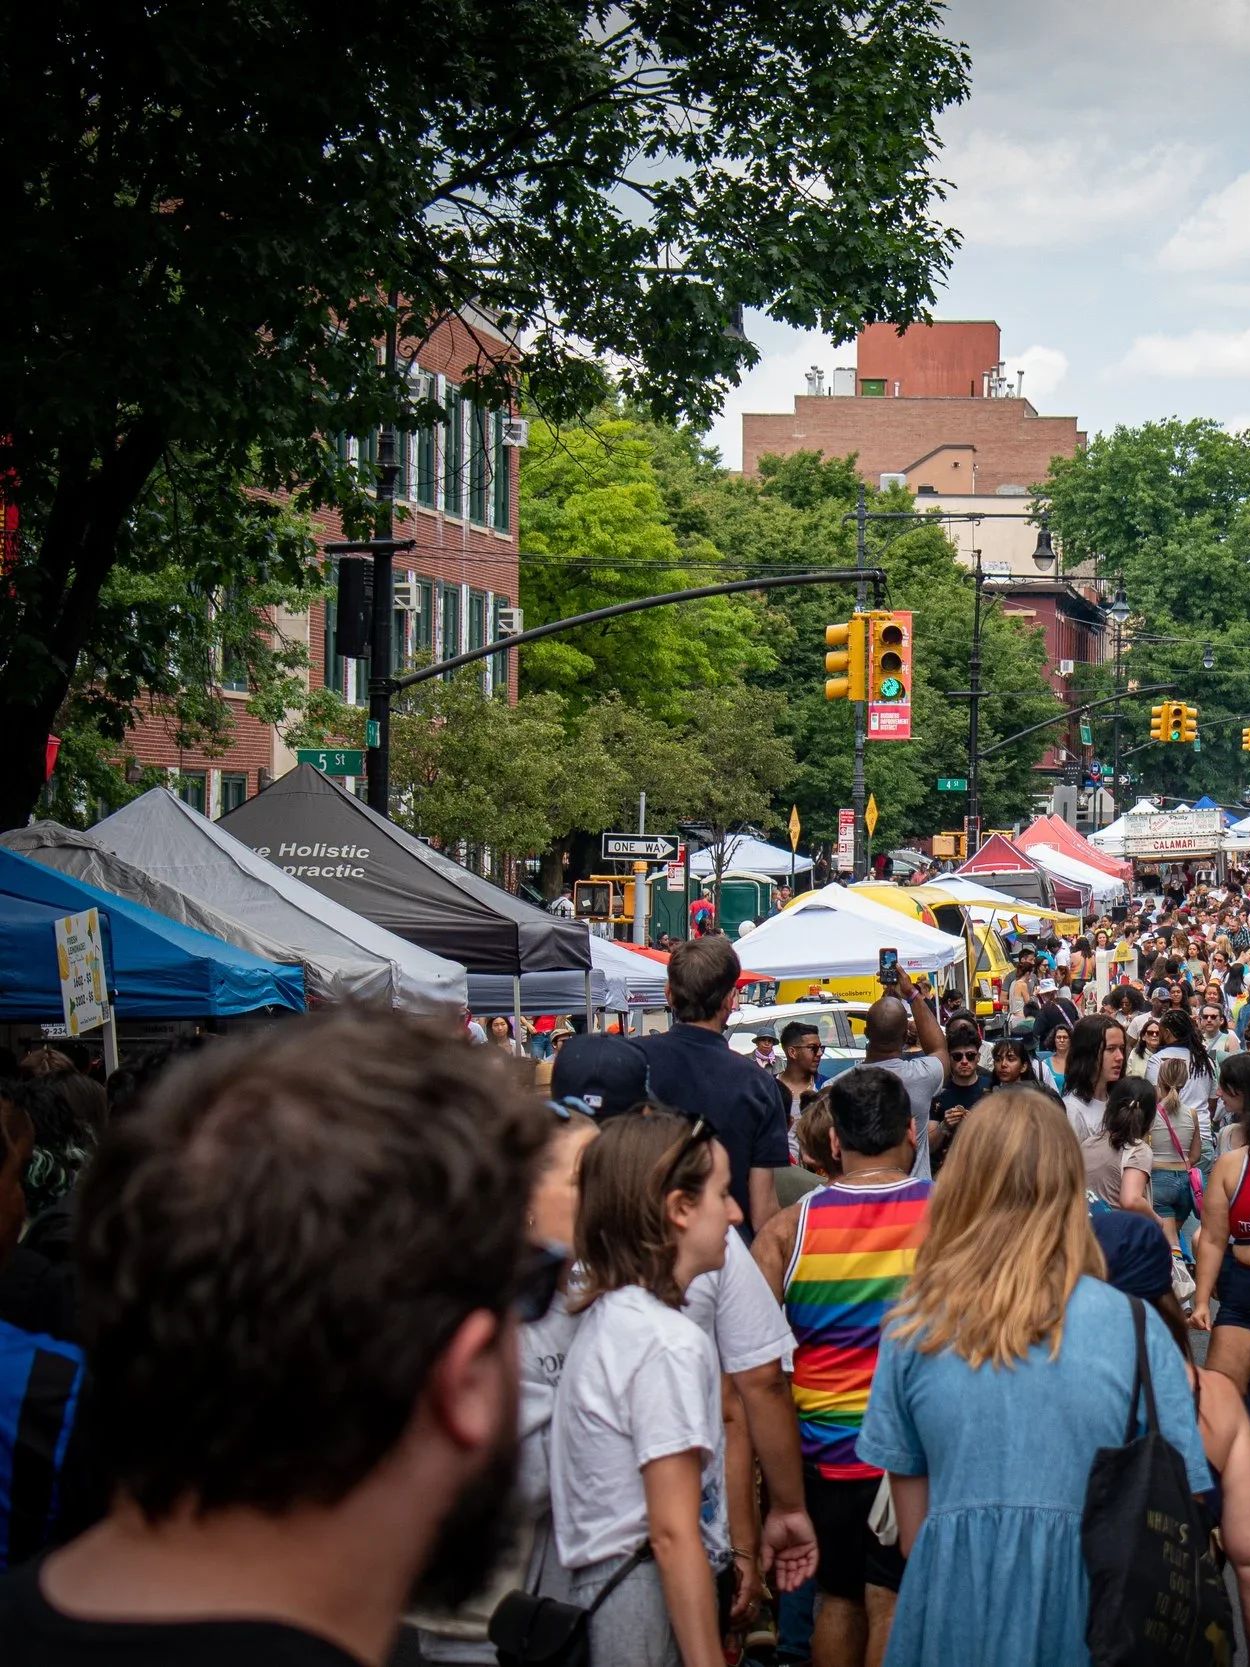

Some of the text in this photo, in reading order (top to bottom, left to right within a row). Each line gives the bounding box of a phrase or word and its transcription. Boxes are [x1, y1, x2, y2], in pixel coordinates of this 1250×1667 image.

[318, 754, 346, 772] 5 St
[946, 780, 951, 789] 4
[279, 843, 370, 858] Holistic
[614, 842, 667, 853] ONE WAY
[1153, 840, 1196, 850] CALAMARI
